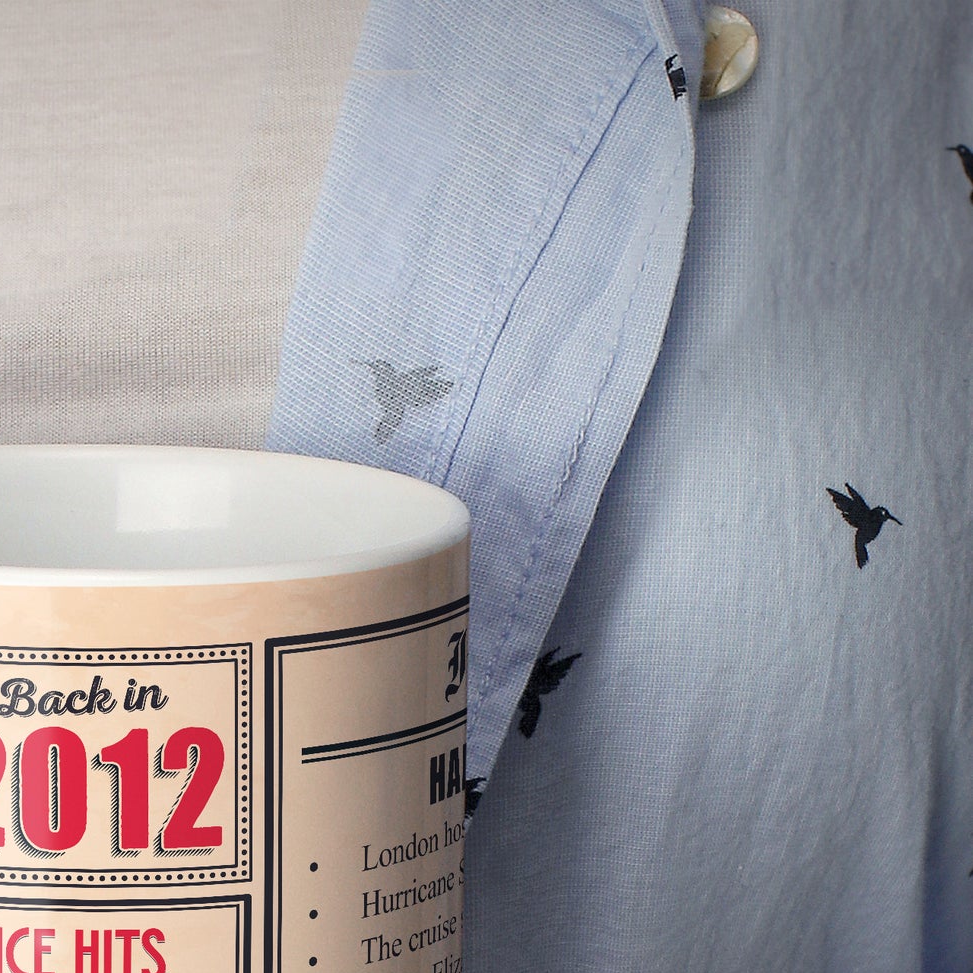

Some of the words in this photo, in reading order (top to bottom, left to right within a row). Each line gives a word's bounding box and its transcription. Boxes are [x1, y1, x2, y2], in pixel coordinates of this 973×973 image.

[123, 678, 169, 712] in
[361, 832, 439, 872] London
[361, 871, 455, 919] Hurricane
[361, 934, 402, 965] The
[408, 914, 457, 952] cruise
